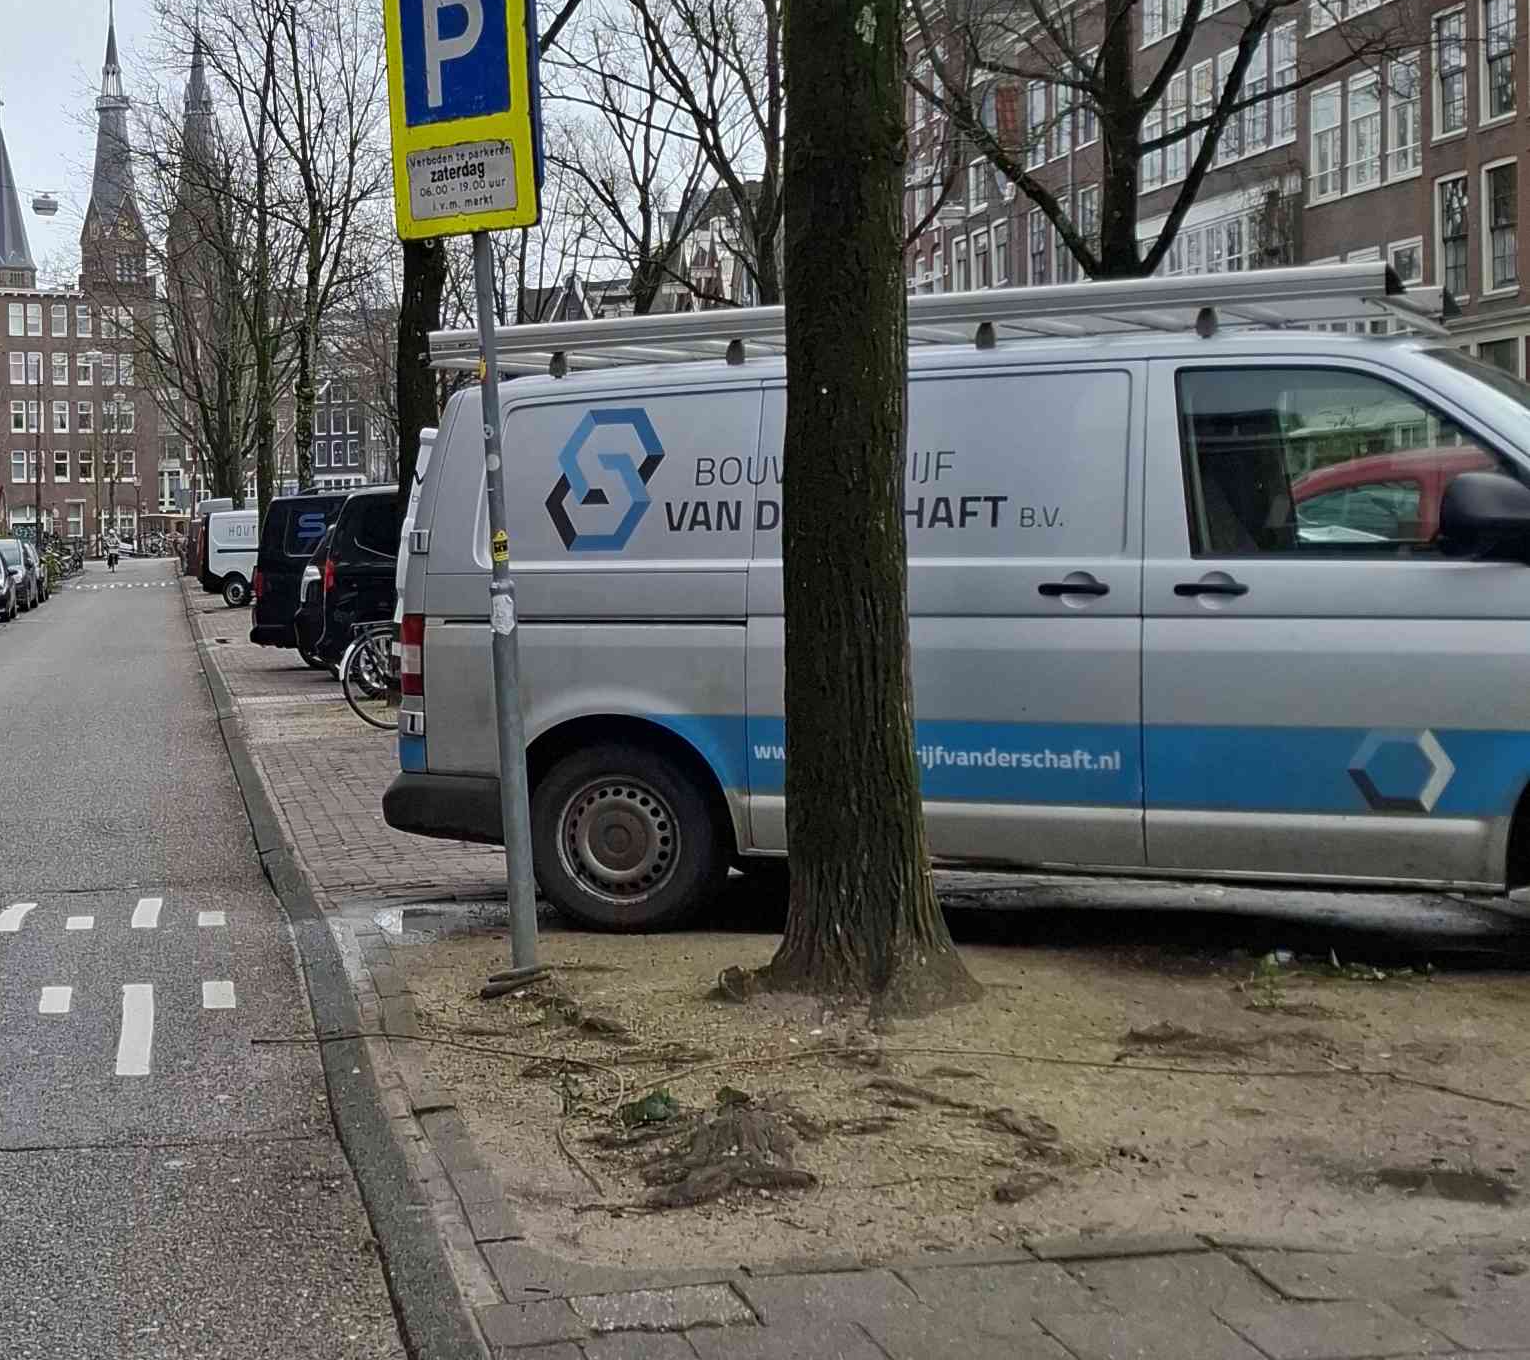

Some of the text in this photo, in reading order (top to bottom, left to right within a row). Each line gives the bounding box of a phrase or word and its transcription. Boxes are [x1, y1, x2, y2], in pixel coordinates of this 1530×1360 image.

[409, 153, 454, 168] Verboden
[456, 151, 465, 161] te
[430, 161, 485, 183] zaterdag
[420, 184, 448, 198] 06.00
[460, 180, 486, 193] 19.00
[489, 178, 506, 189] uur
[665, 500, 742, 532] VAN
[1019, 507, 1064, 528] B.V.
